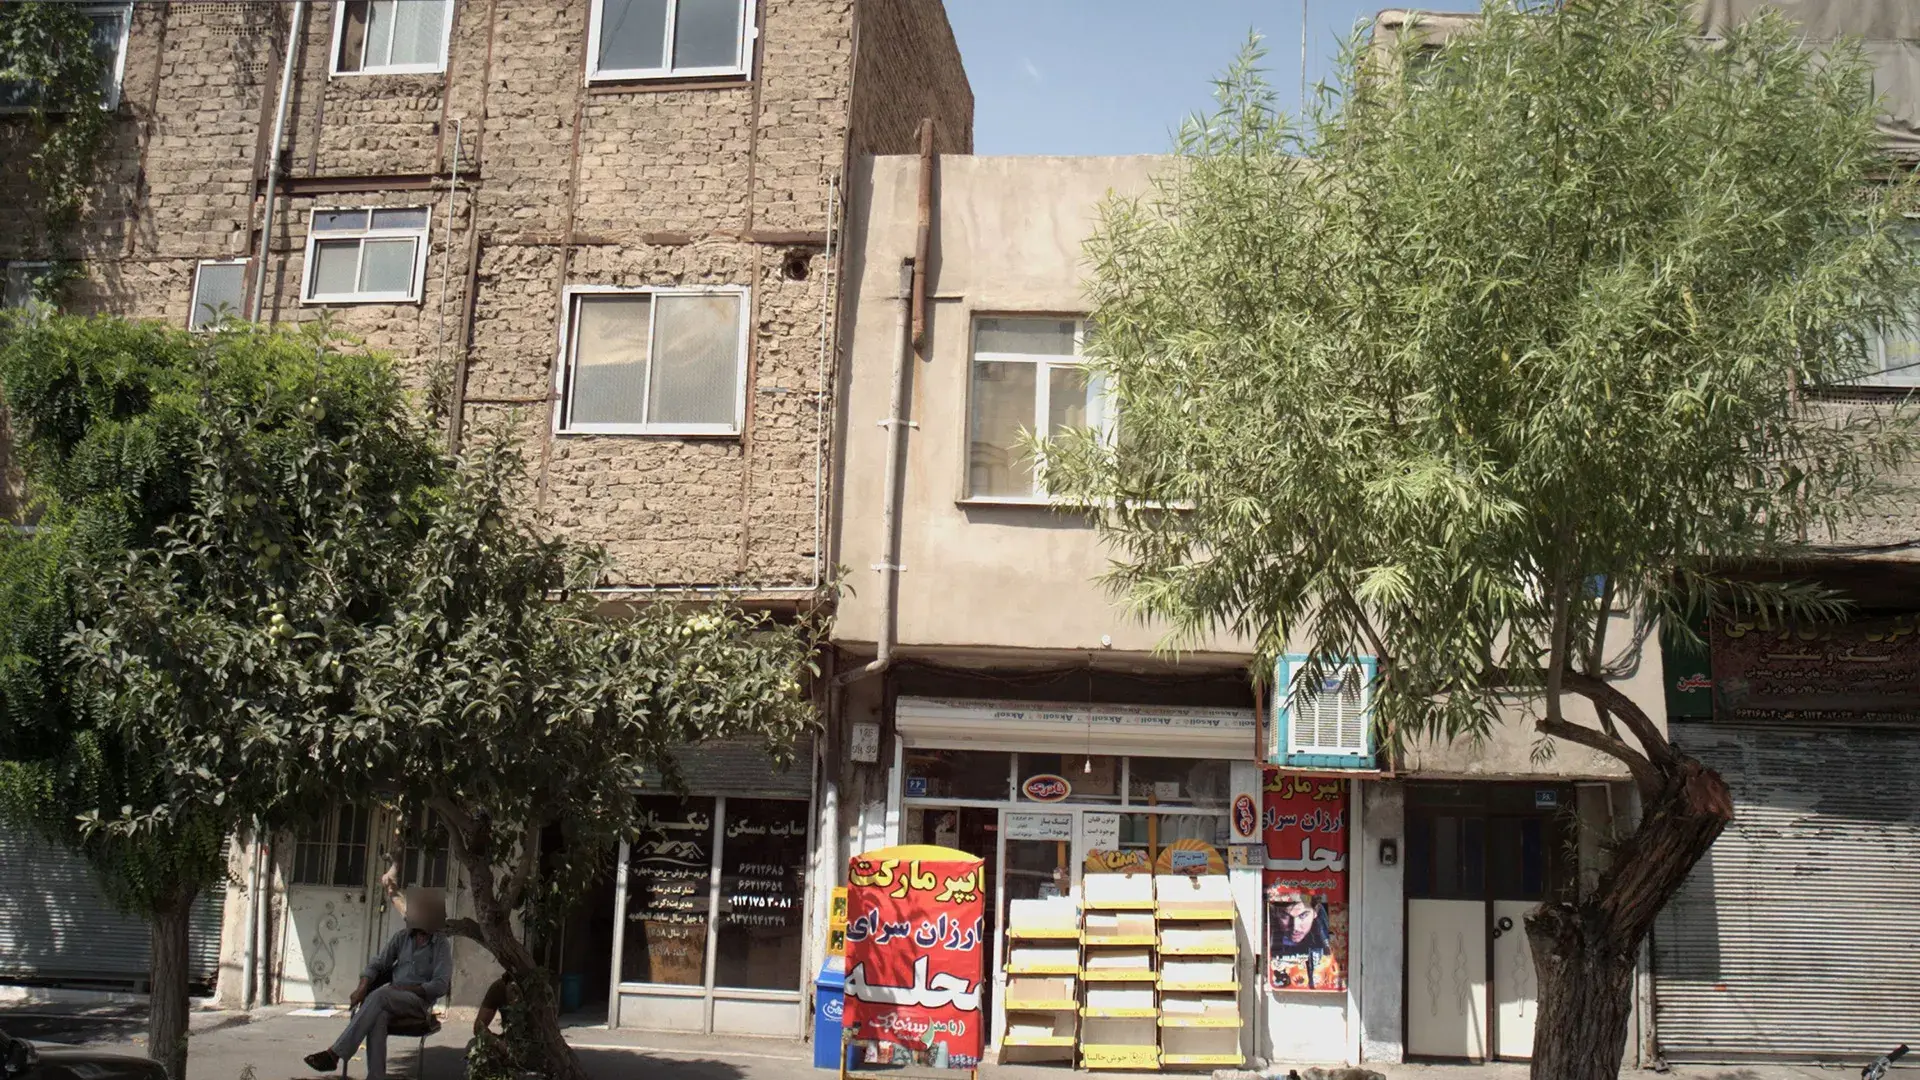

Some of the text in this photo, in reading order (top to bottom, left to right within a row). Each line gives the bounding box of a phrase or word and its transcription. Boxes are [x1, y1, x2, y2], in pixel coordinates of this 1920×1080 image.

[1827, 652, 1834, 666] و
[727, 818, 806, 839] سایت مسکن
[1301, 807, 1345, 833] ارزان
[849, 858, 937, 899] مارکت
[667, 928, 681, 939] سال
[846, 908, 983, 950] ارزان سرای
